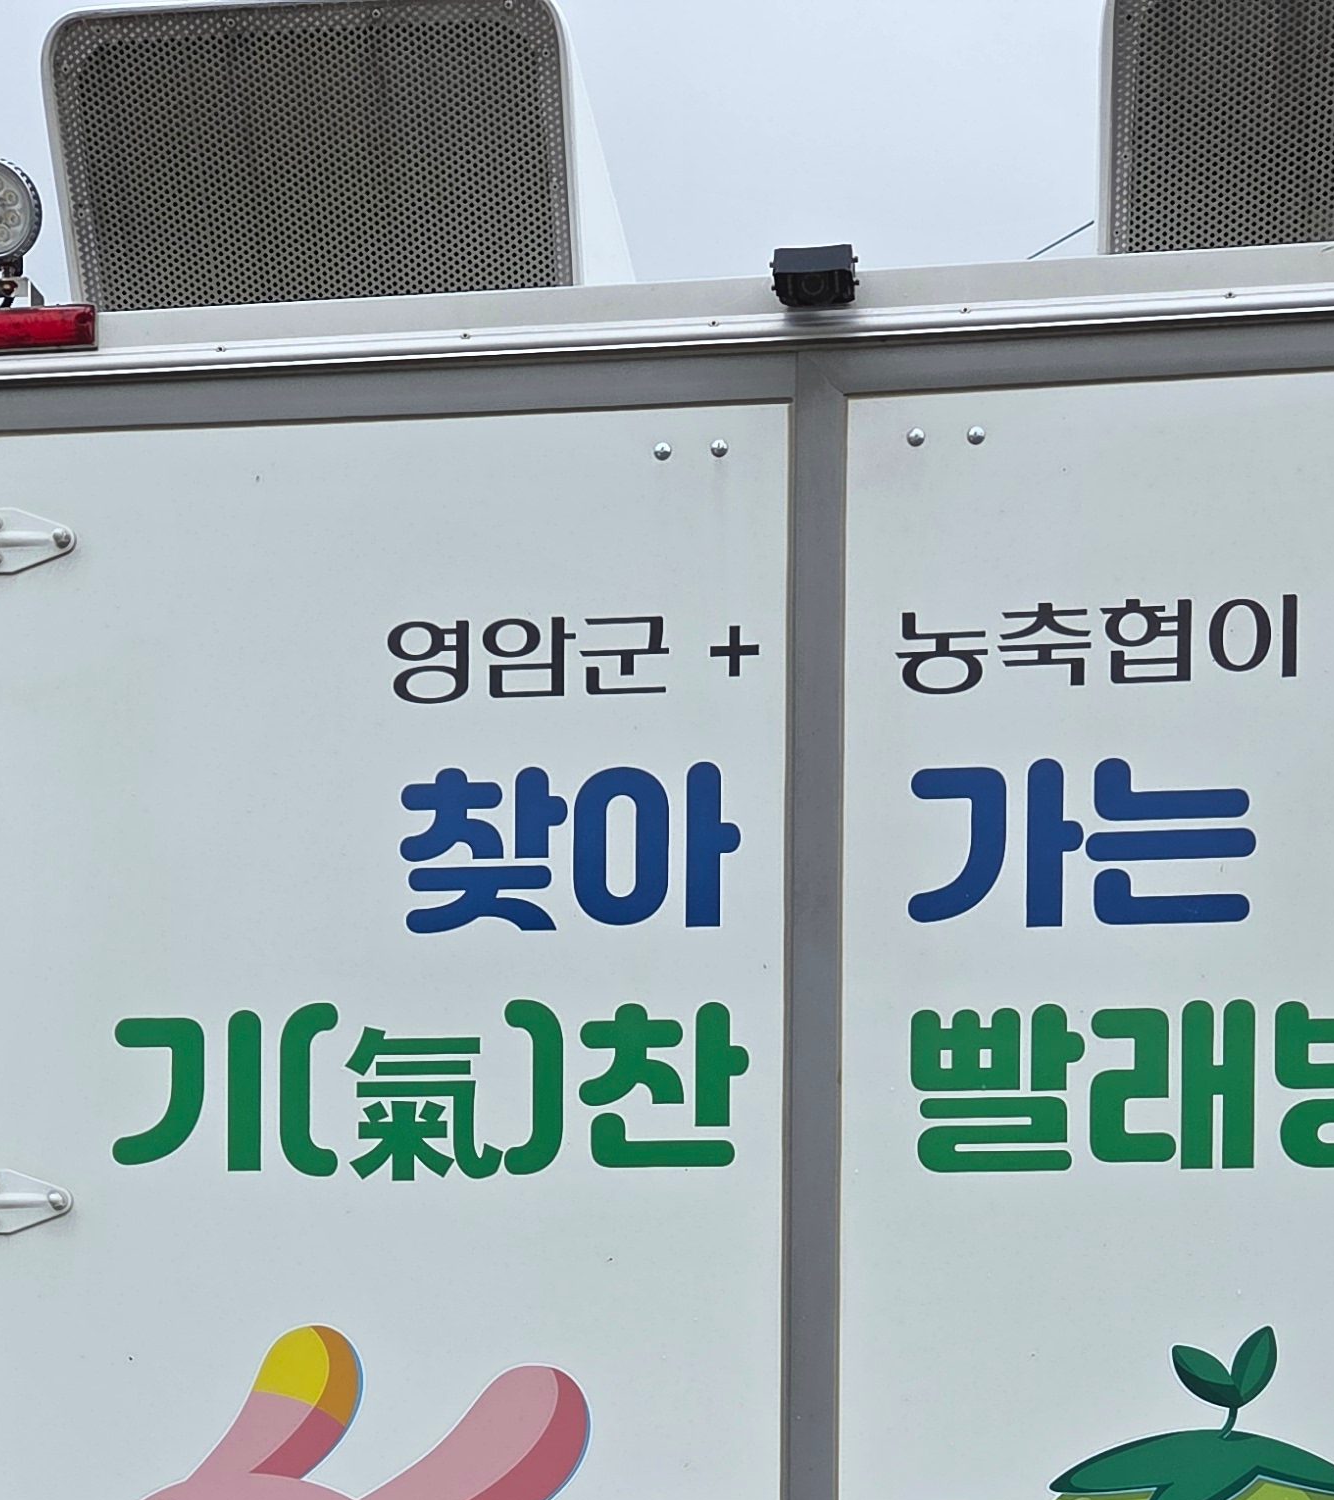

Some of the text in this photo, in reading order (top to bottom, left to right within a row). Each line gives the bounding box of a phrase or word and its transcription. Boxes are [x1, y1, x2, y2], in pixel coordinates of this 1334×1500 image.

[386, 614, 671, 706] 영암군
[894, 593, 1298, 695] 농축협이
[399, 757, 1257, 934] 찾아 가는
[112, 999, 750, 1182] 기(氣)찬
